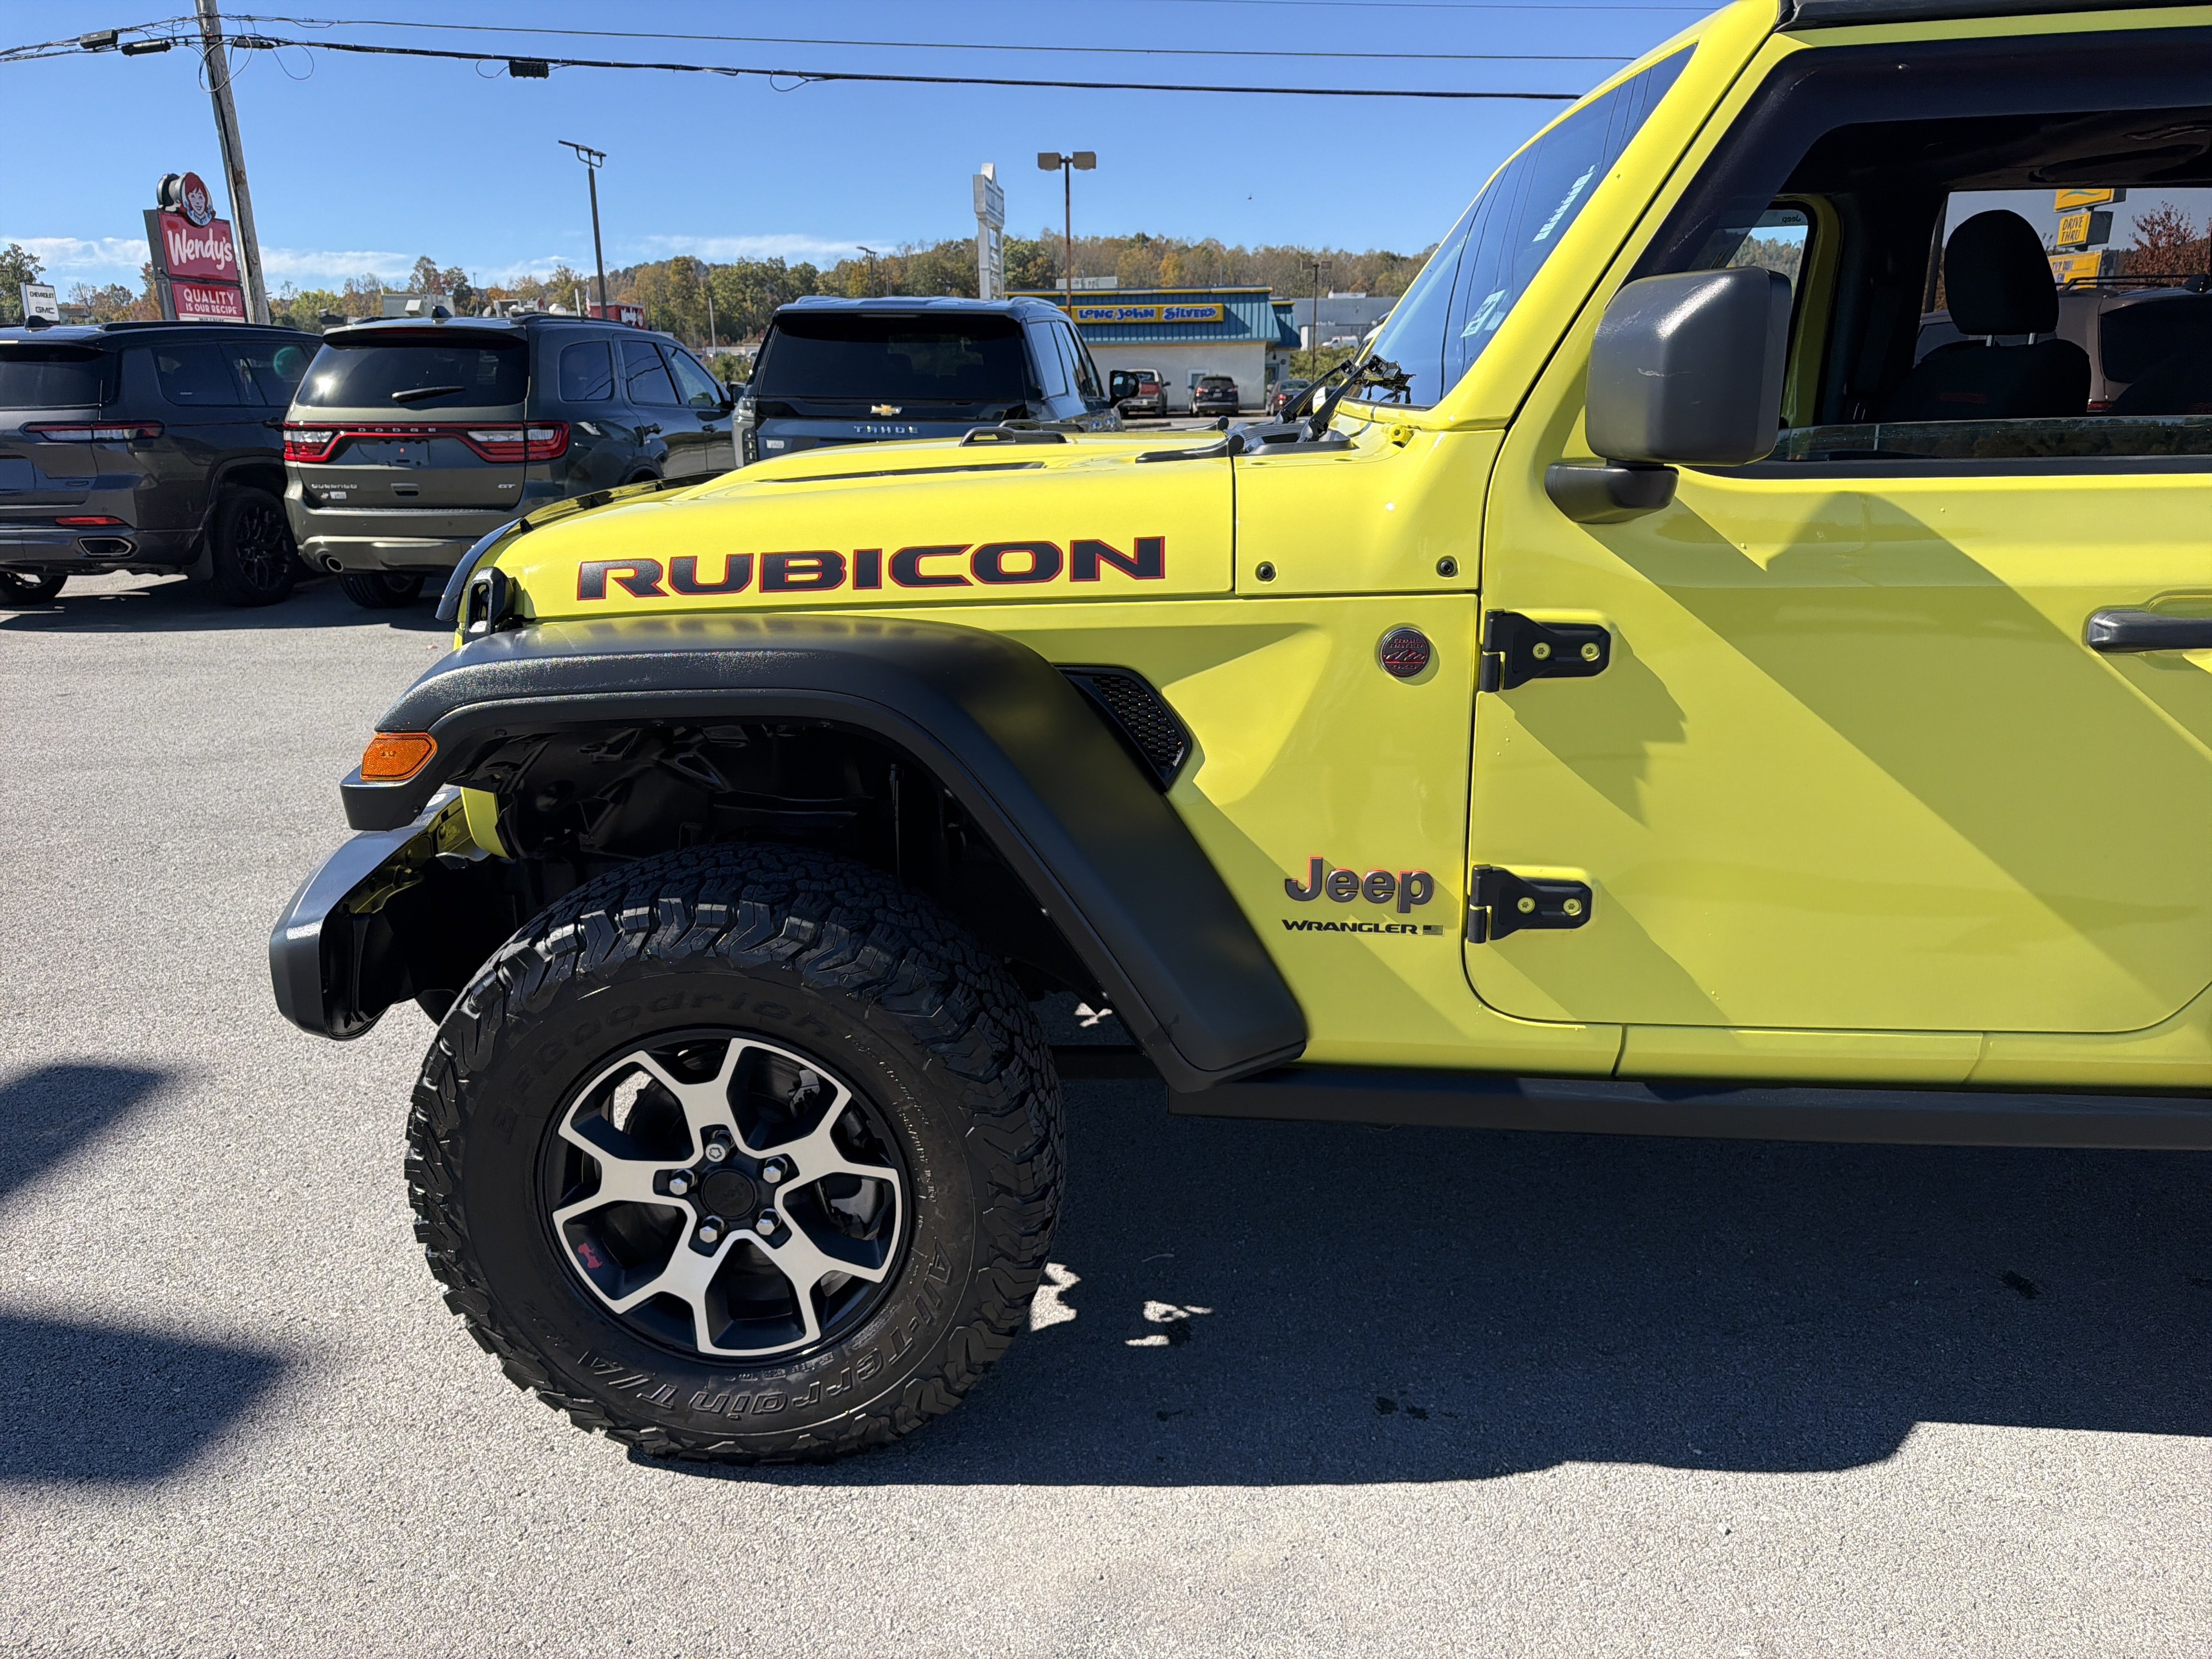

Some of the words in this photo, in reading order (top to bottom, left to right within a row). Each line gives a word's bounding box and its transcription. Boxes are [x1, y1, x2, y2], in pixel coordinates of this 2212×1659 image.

[2062, 216, 2084, 231] DRIVE
[2061, 230, 2081, 242] THRU
[167, 228, 233, 270] Wendy's
[183, 287, 234, 305] QUALITY
[35, 306, 55, 314] GMC
[185, 303, 193, 312] IS
[195, 303, 210, 313] OUR
[211, 304, 237, 315] RECIPE
[854, 425, 919, 433] TAHOE
[577, 535, 1165, 601] RUBICON
[1284, 855, 1434, 913] Jeep
[1282, 919, 1418, 935] WRANGLER
[687, 1236, 953, 1420] All-Terrain
